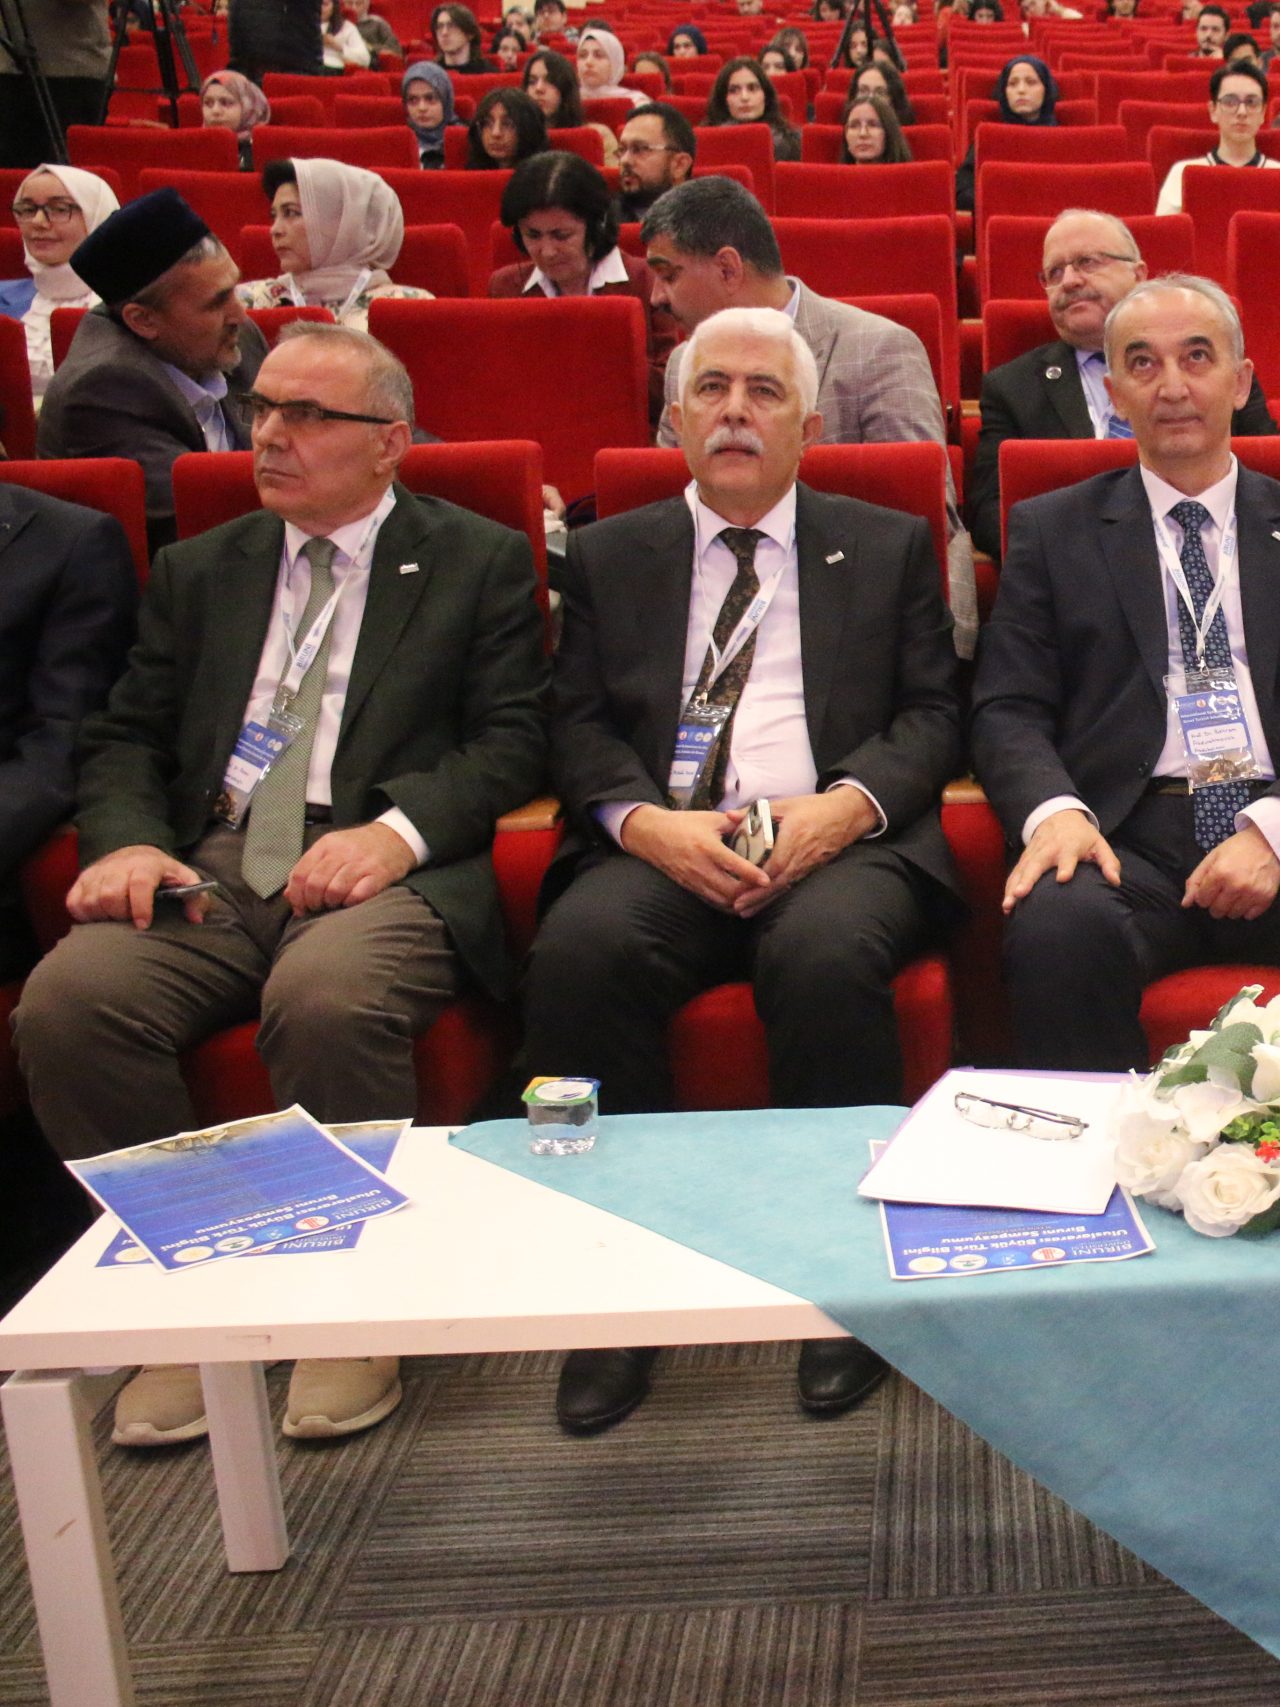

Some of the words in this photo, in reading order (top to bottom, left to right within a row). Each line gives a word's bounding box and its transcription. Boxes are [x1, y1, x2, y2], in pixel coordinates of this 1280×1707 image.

[212, 1226, 246, 1239] Türk
[954, 1243, 987, 1252] Türk
[990, 1238, 1037, 1249] Büyük
